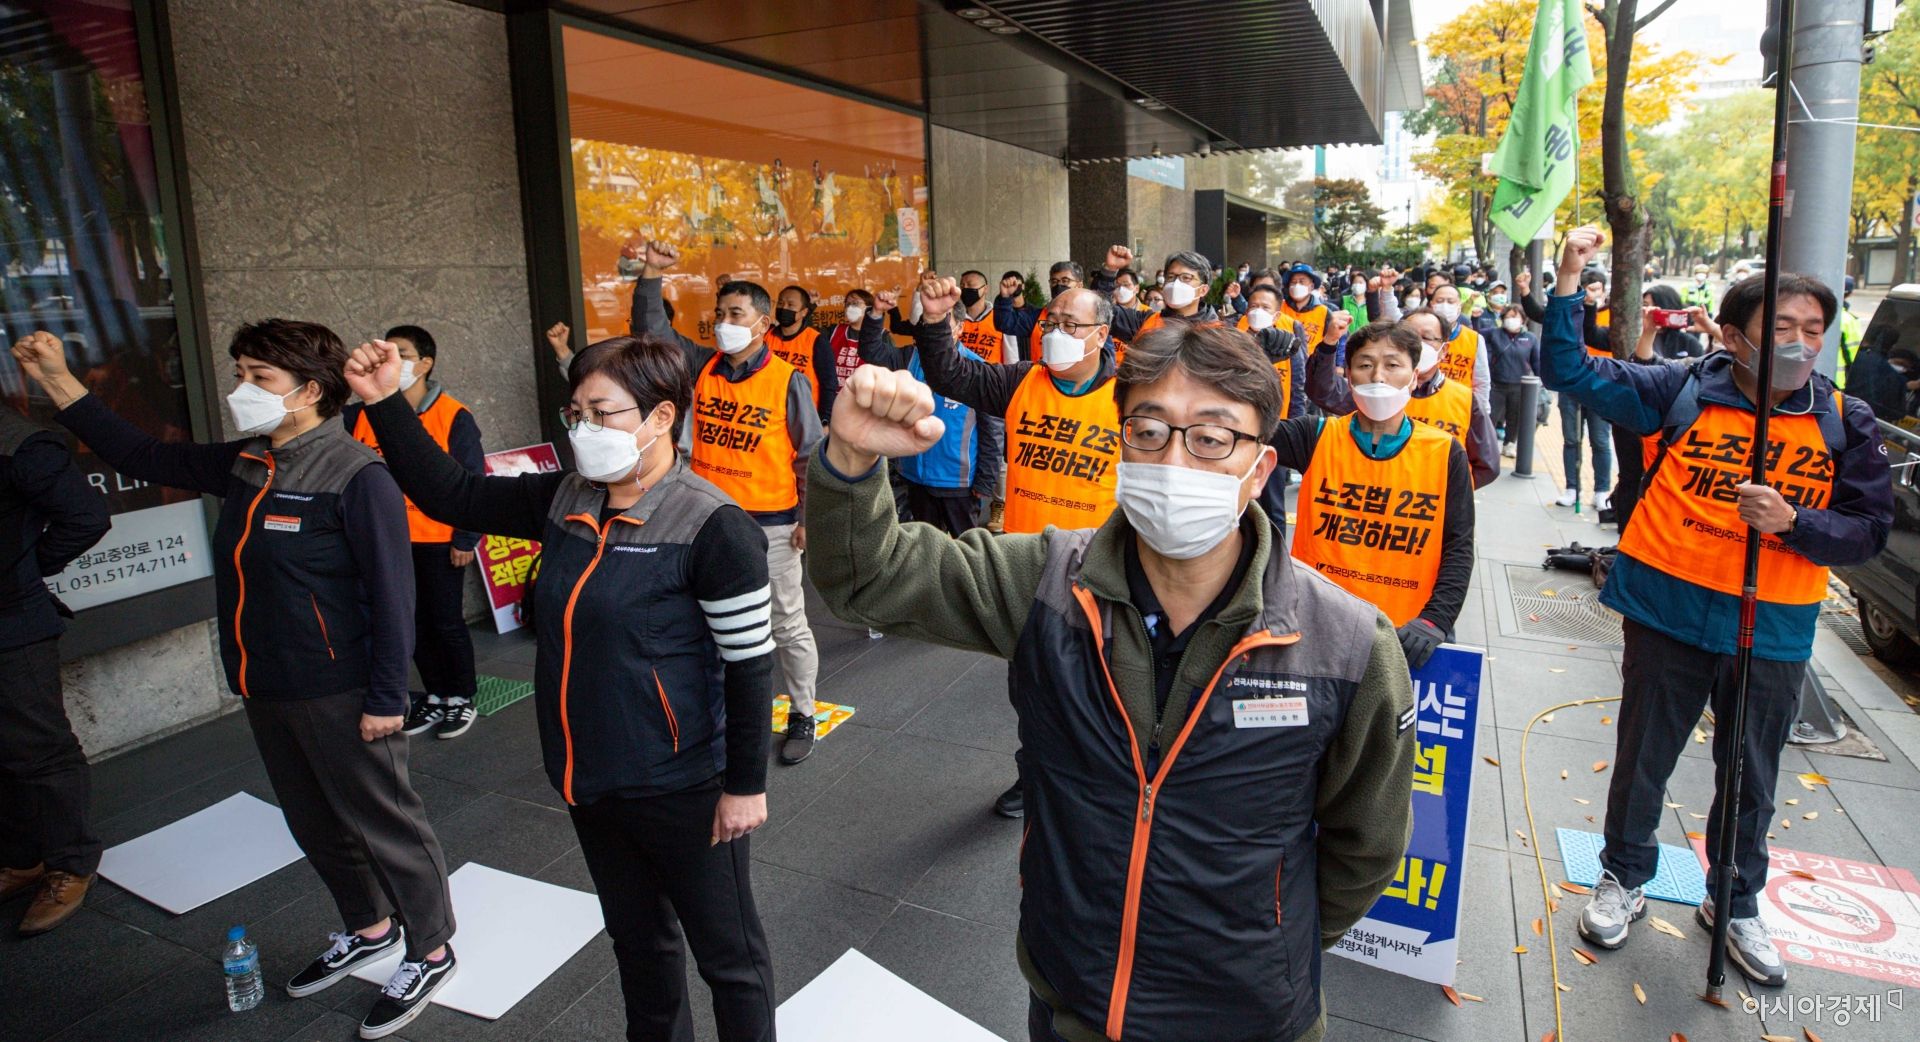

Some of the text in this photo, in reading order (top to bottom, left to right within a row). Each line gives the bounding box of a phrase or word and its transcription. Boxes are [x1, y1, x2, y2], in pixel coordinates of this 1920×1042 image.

[696, 393, 772, 429] 노조법 2조
[1016, 411, 1121, 455] 노조법 2조
[1014, 441, 1109, 482] 개정하라!
[1787, 445, 1833, 483] 2조
[1313, 477, 1440, 522] 노조법 2조
[77, 535, 184, 570] 광교중앙로 124
[1313, 511, 1432, 556] 개정하라!
[69, 552, 188, 591] 031.5174.7114
[1326, 563, 1419, 590] 전국민주노동조합총연맹
